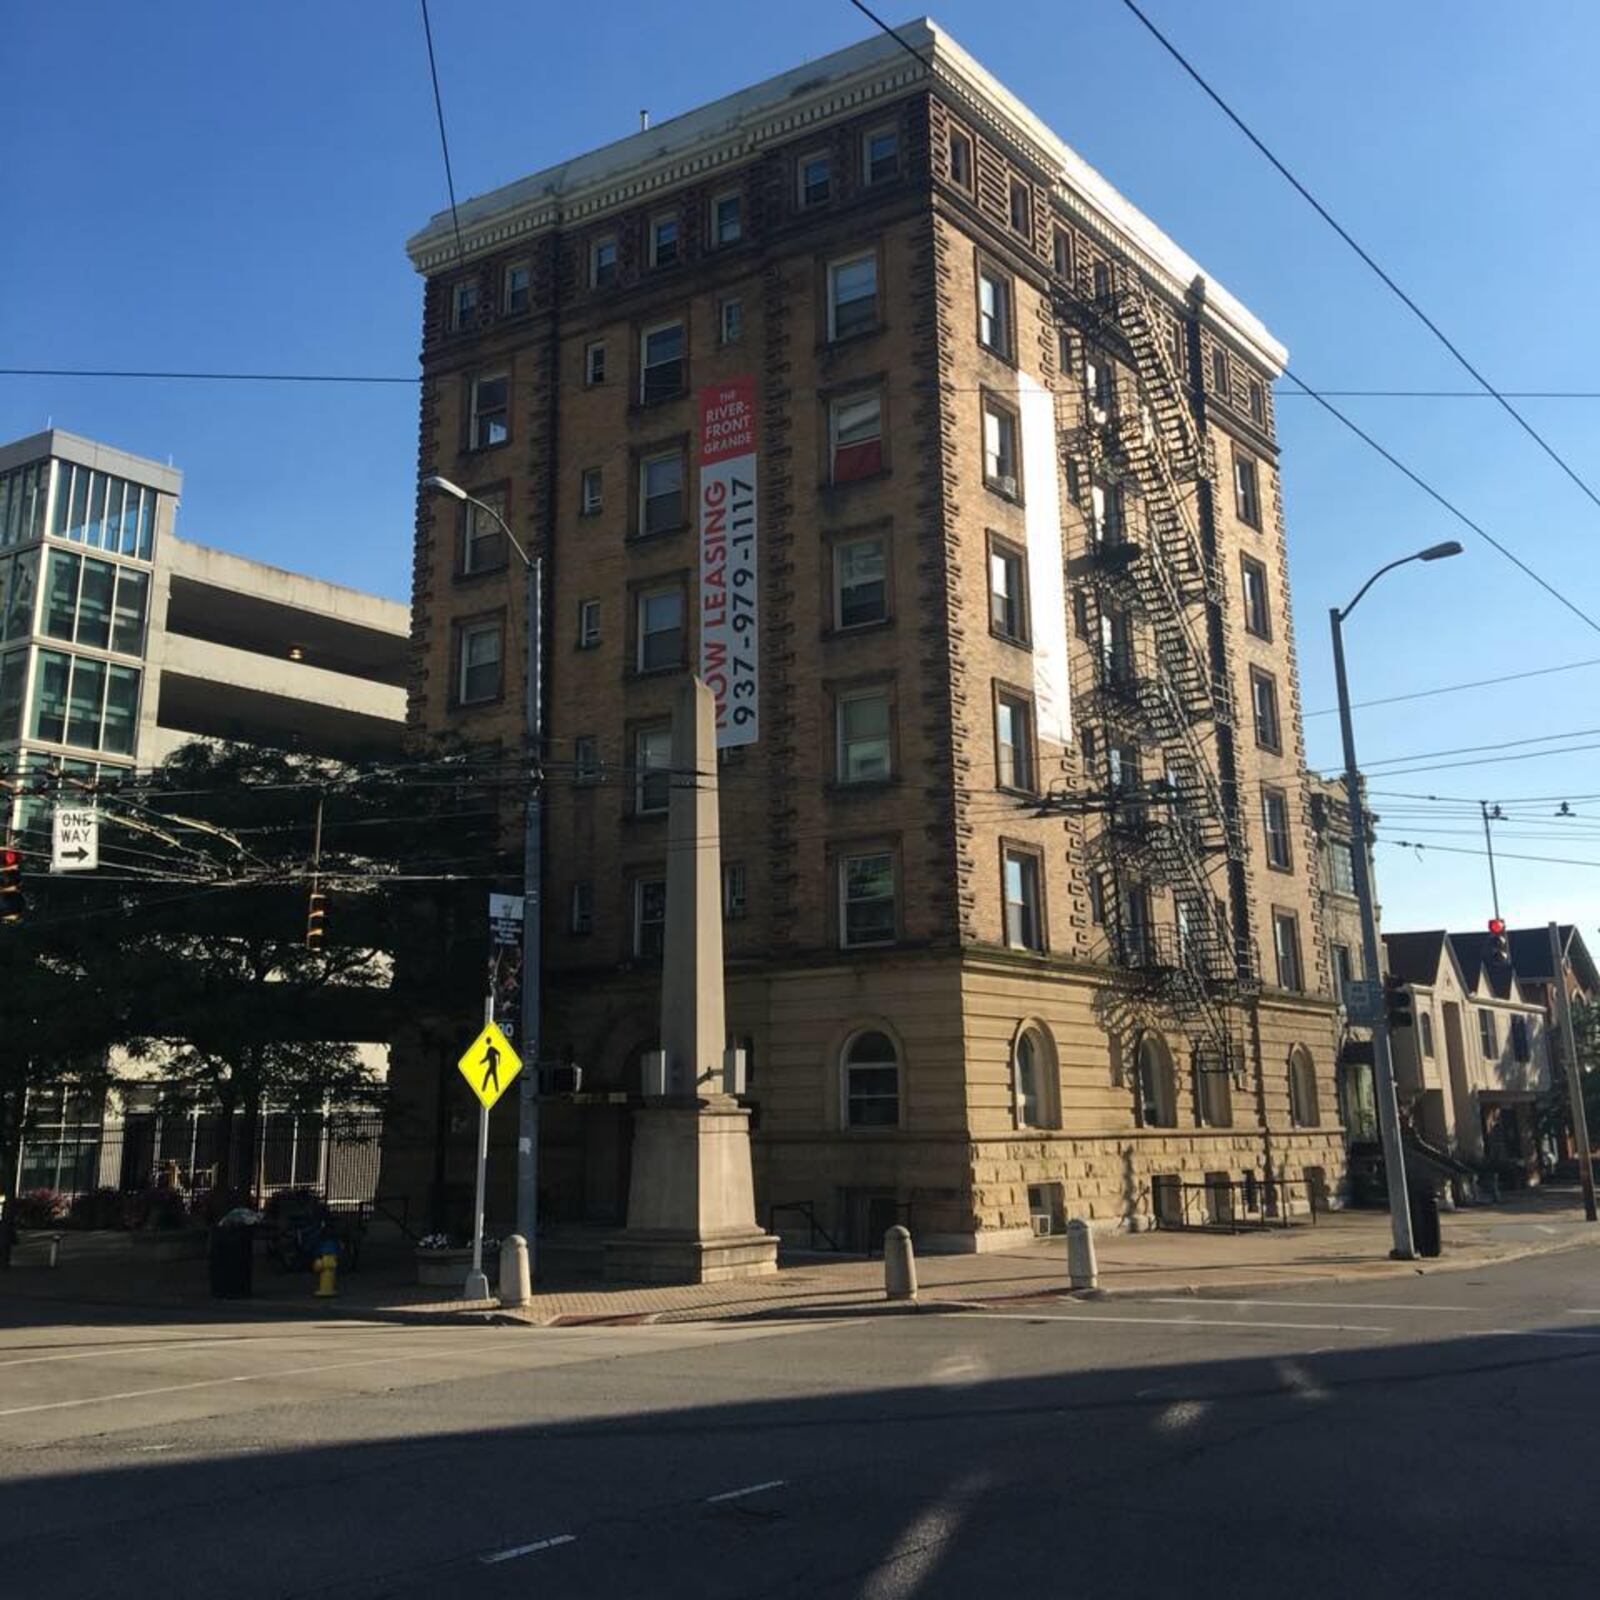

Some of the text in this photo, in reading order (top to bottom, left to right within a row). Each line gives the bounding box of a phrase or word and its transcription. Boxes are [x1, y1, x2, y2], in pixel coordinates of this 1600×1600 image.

[706, 401, 750, 424] RIVER-
[706, 415, 750, 440] FRONT
[704, 431, 752, 454] GRANDE
[704, 481, 727, 628] LEASING
[731, 477, 755, 725] 937-979-1117
[62, 812, 91, 827] ONE
[61, 829, 90, 843] WAY
